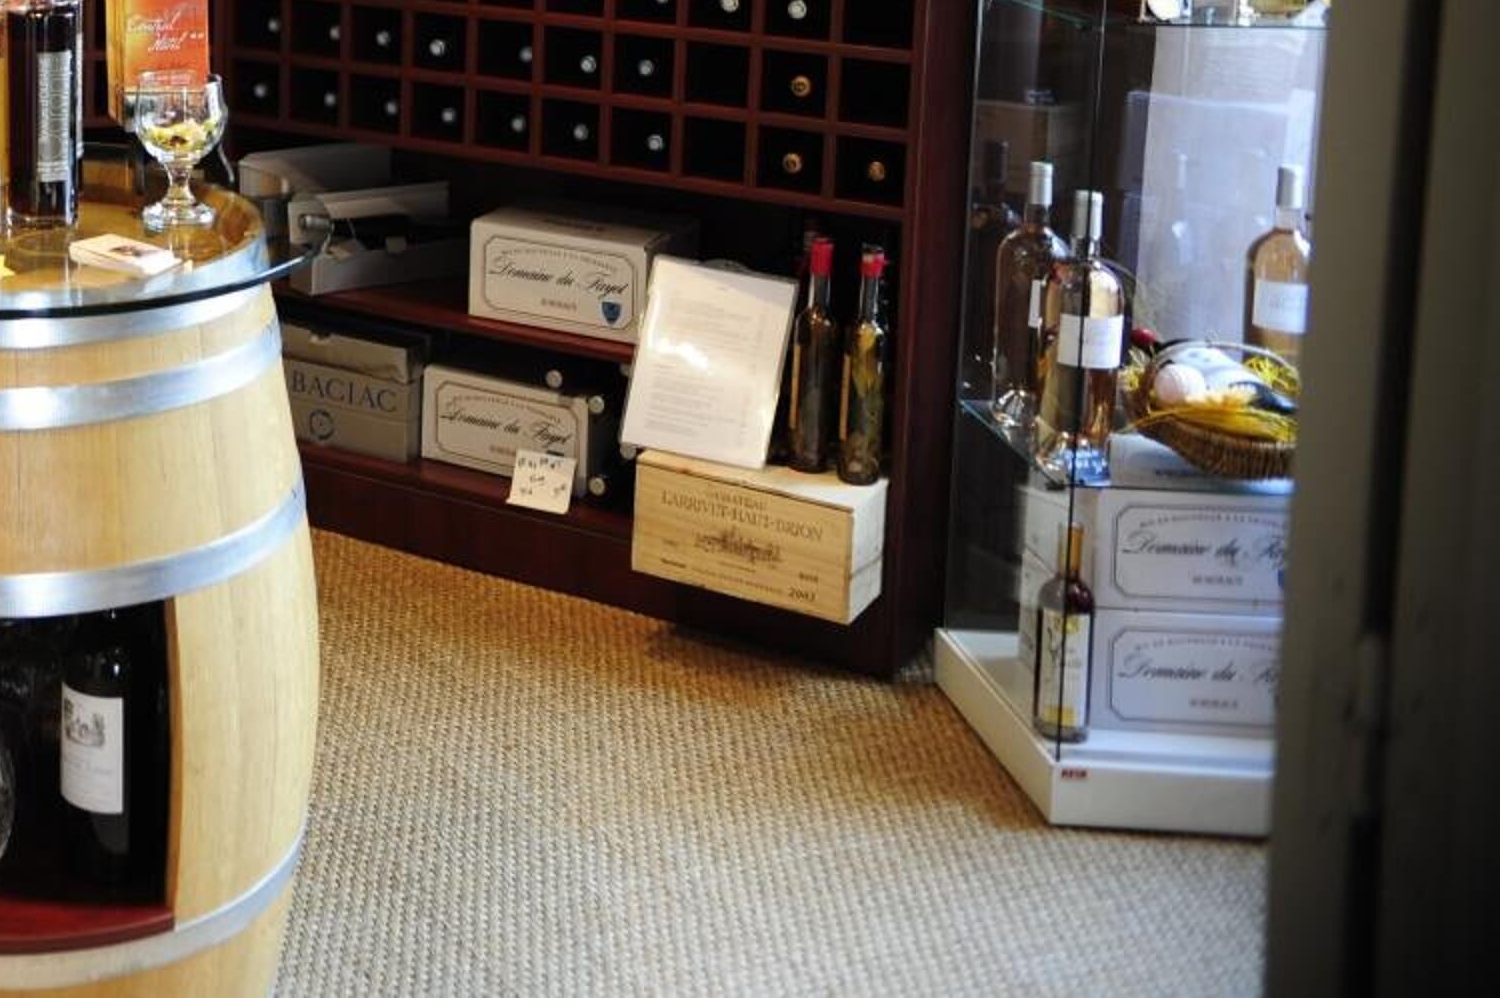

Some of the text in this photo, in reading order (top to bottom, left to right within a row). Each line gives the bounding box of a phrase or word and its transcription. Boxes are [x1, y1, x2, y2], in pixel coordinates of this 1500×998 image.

[489, 254, 553, 282] Domaine
[556, 270, 576, 286] du
[440, 402, 499, 430] Domaine
[502, 416, 520, 435] du
[1122, 530, 1213, 555] Domaine
